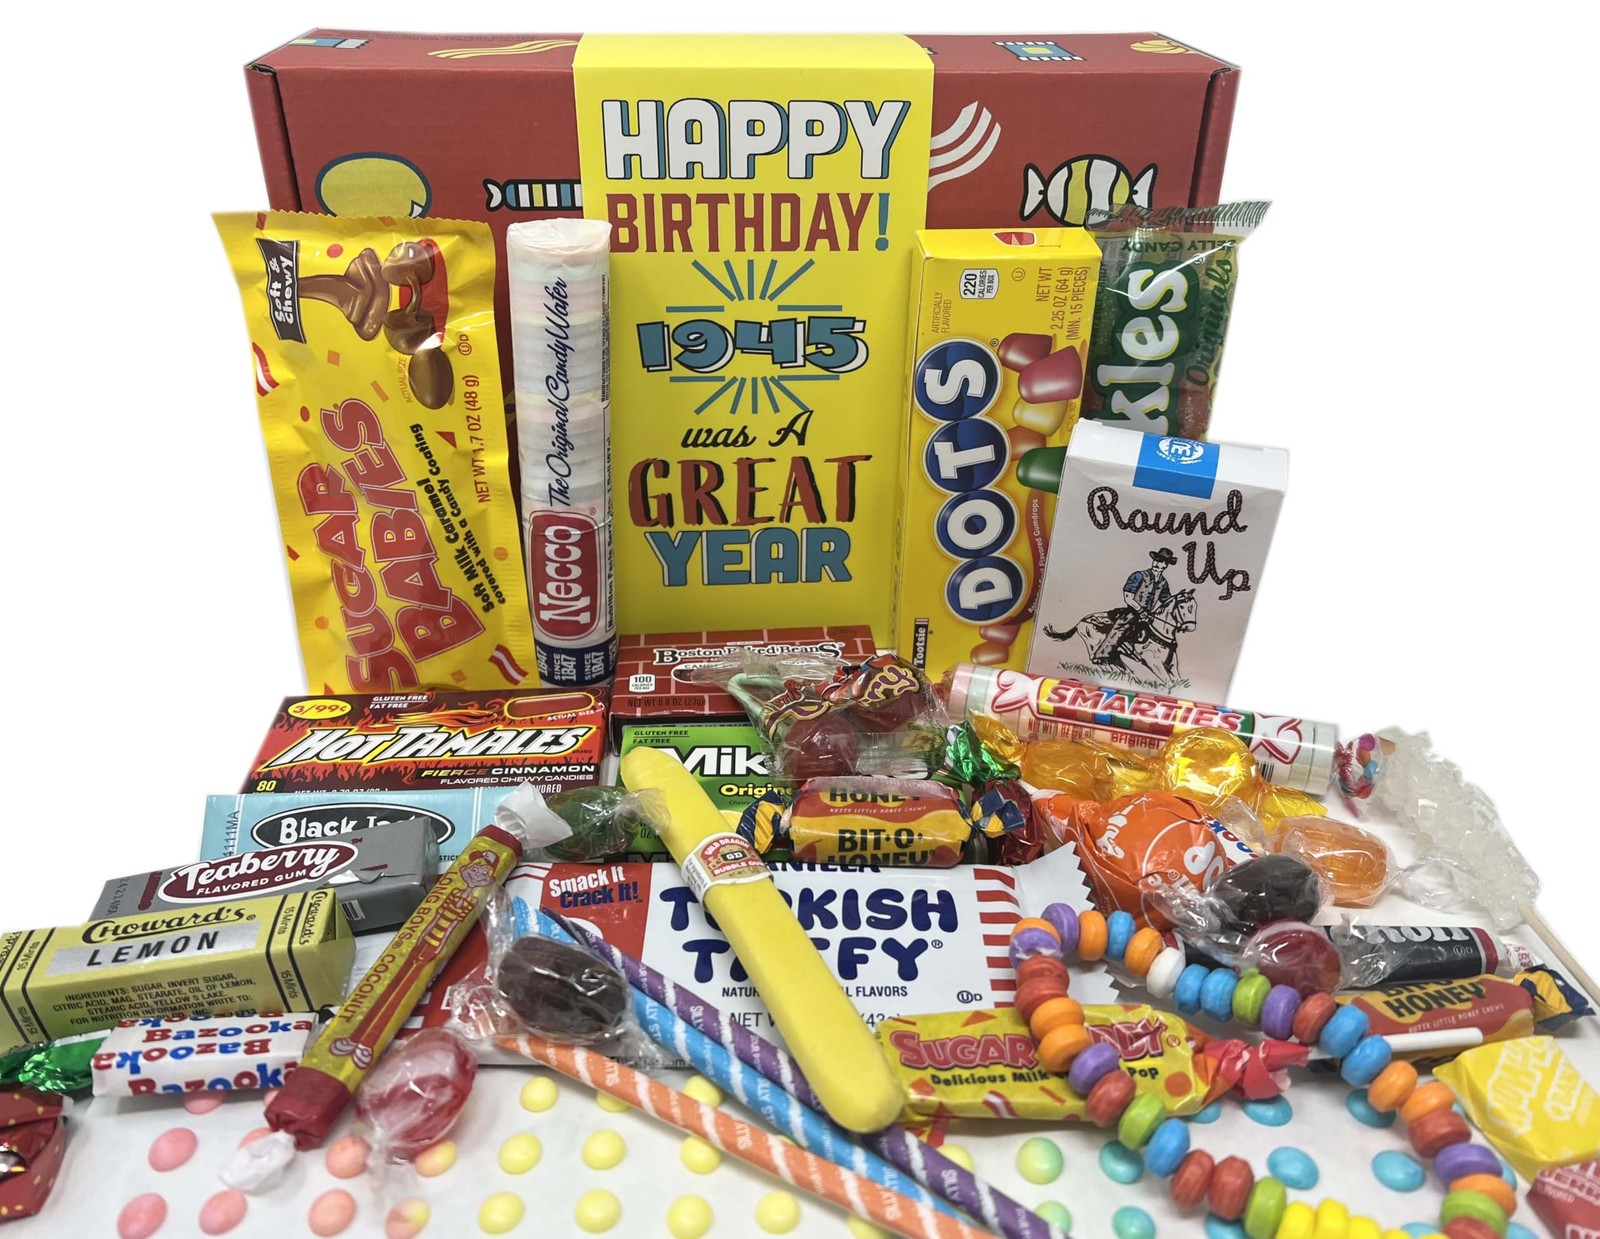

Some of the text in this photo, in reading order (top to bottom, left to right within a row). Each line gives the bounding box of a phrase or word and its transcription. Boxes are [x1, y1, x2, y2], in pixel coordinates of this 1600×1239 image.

[602, 98, 911, 179] HAPPY
[606, 193, 889, 252] BIRTHDAY!
[964, 273, 978, 296] 220
[978, 269, 987, 298] CALORIES
[986, 283, 994, 294] PER
[1036, 267, 1052, 302] NET WT
[1050, 267, 1074, 330] 2.25 OZ (64 g)
[269, 281, 286, 323] Soft
[931, 291, 942, 333] ARTIFICIALLY
[941, 299, 952, 333] FLAVORED
[1066, 267, 1091, 340] (MIN. 15 PIECES)
[637, 316, 869, 373] 1945
[543, 277, 575, 507] The Original Candy Wafer
[462, 374, 491, 503] NET WT 1.7 OZ (48 g)
[681, 410, 814, 448] was A
[628, 455, 872, 527] GREAT
[924, 359, 1013, 609] DOTS
[409, 423, 506, 605] covered with a candy coating
[1031, 498, 1041, 536] Gumdrops
[1087, 486, 1248, 536] Round
[320, 398, 486, 663] BABIES
[416, 477, 495, 614] Soft Milk Caramel
[645, 527, 852, 586] YEAR
[1034, 537, 1046, 567] Flavored
[297, 462, 421, 693] SUGAR
[539, 525, 590, 624] Necco
[1182, 541, 1251, 600] Up
[653, 648, 723, 665] Boston
[914, 626, 926, 666] Tootsie
[561, 654, 576, 682] 1847
[584, 653, 592, 681] SINCE
[591, 651, 605, 680] 1847
[547, 709, 595, 721] ACTUAL SIZE
[628, 699, 642, 707] NET
[644, 698, 656, 707] WT
[1047, 684, 1244, 732] SMARTIES
[262, 726, 592, 769] HOT TAMALES
[655, 746, 770, 776] Mik
[256, 780, 277, 791] 80
[421, 765, 594, 777] FIERCE CINNAMON
[440, 777, 499, 785] FLAVORED
[279, 816, 358, 845] Black
[705, 838, 749, 856] GOLD DRAGON
[178, 846, 341, 892] Teaberry
[714, 861, 747, 875] BUBBLE
[726, 852, 743, 860] GD
[196, 869, 308, 896] FLAVORED GUM
[549, 865, 628, 898] Smack It
[560, 881, 641, 909] Crack It!
[659, 886, 958, 933] TKISH
[87, 931, 220, 967] LEMON
[338, 870, 459, 1023] LONG BOYS COCONUT
[682, 937, 929, 984] TFY
[52, 978, 256, 1012] CITRIC ACID, MAG. STEARATE, OIL OF LEMON,
[65, 973, 237, 1002] INGREDIENTS: SUGAR, INVERT SUGAR,
[87, 1004, 127, 1016] STEARIC
[128, 1001, 150, 1012] ACID,
[152, 995, 191, 1008] YELLOW
[192, 994, 200, 1002] 5
[855, 986, 908, 998] FLAVORS
[1383, 981, 1484, 1018] HONEY
[69, 1016, 90, 1027] FOR
[91, 1010, 140, 1024] NUTRITION
[142, 1002, 205, 1017] INFORMATION
[206, 997, 235, 1008] WRITE
[1408, 1023, 1431, 1033] NUTTY
[1432, 1017, 1457, 1029] LITTLE
[1458, 1010, 1480, 1021] HONEY
[142, 1020, 313, 1042] Bazooka
[92, 1038, 272, 1075] Bazooka
[890, 1030, 1040, 1070] SUGAR
[930, 1065, 1159, 1087] Delicious Milk Pop
